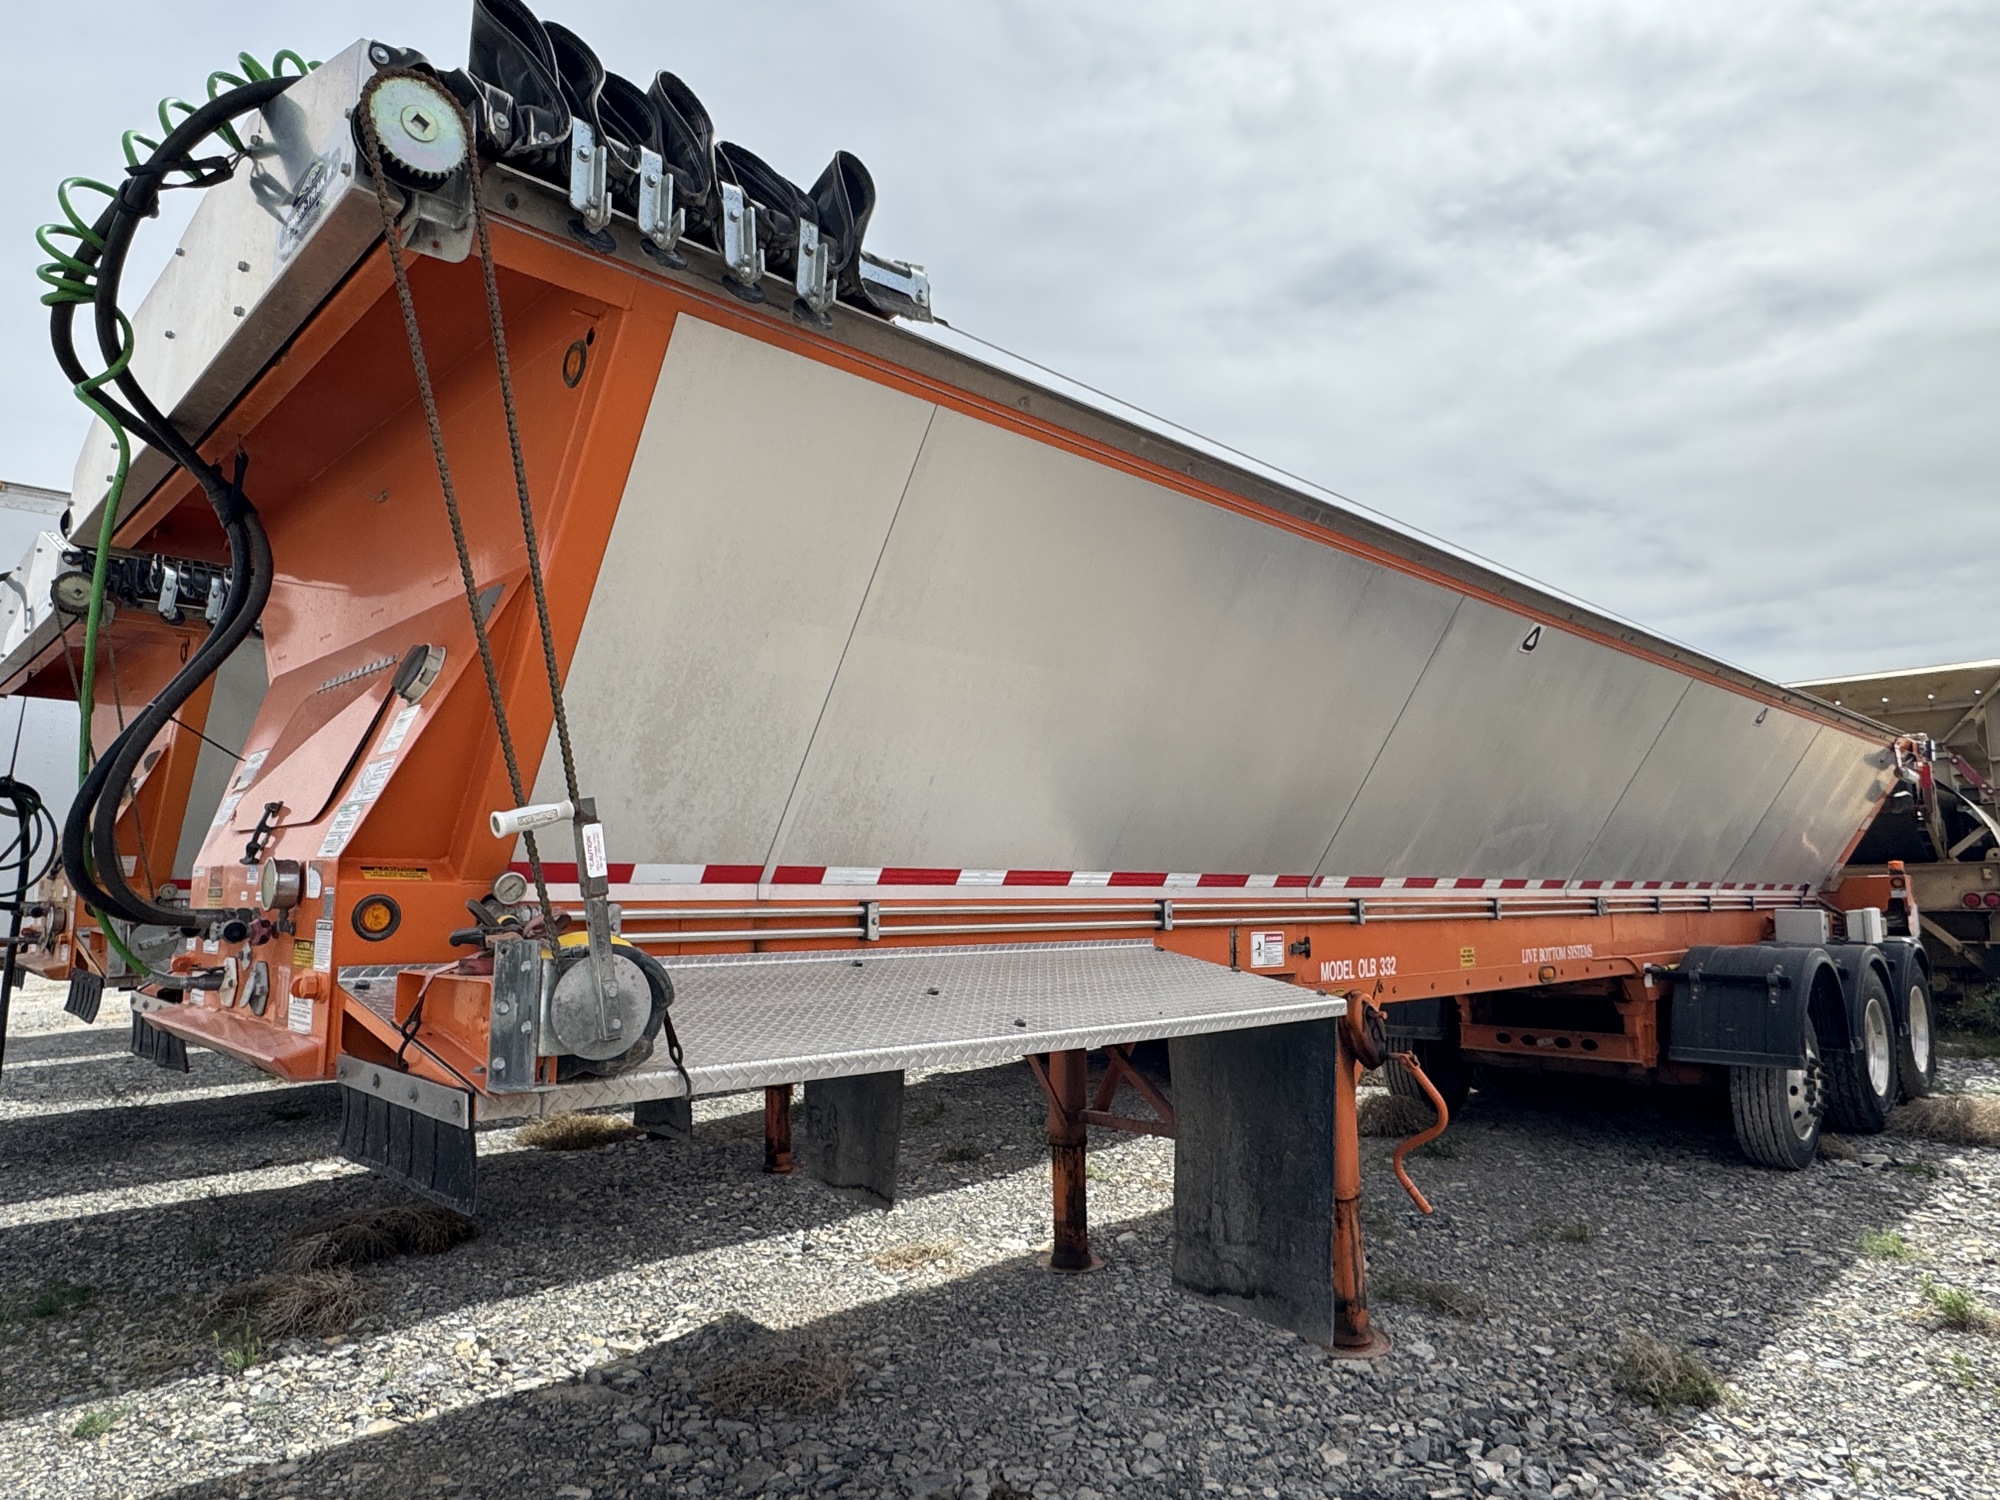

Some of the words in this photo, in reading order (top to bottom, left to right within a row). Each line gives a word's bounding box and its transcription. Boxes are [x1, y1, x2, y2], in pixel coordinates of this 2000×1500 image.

[1521, 947, 1538, 964] LIVE
[1539, 946, 1566, 962] BOTTOM
[1567, 944, 1593, 960] SYSTEMS
[1320, 960, 1355, 982] MODEL
[1358, 957, 1377, 979] OLB
[1379, 956, 1397, 976] 332
